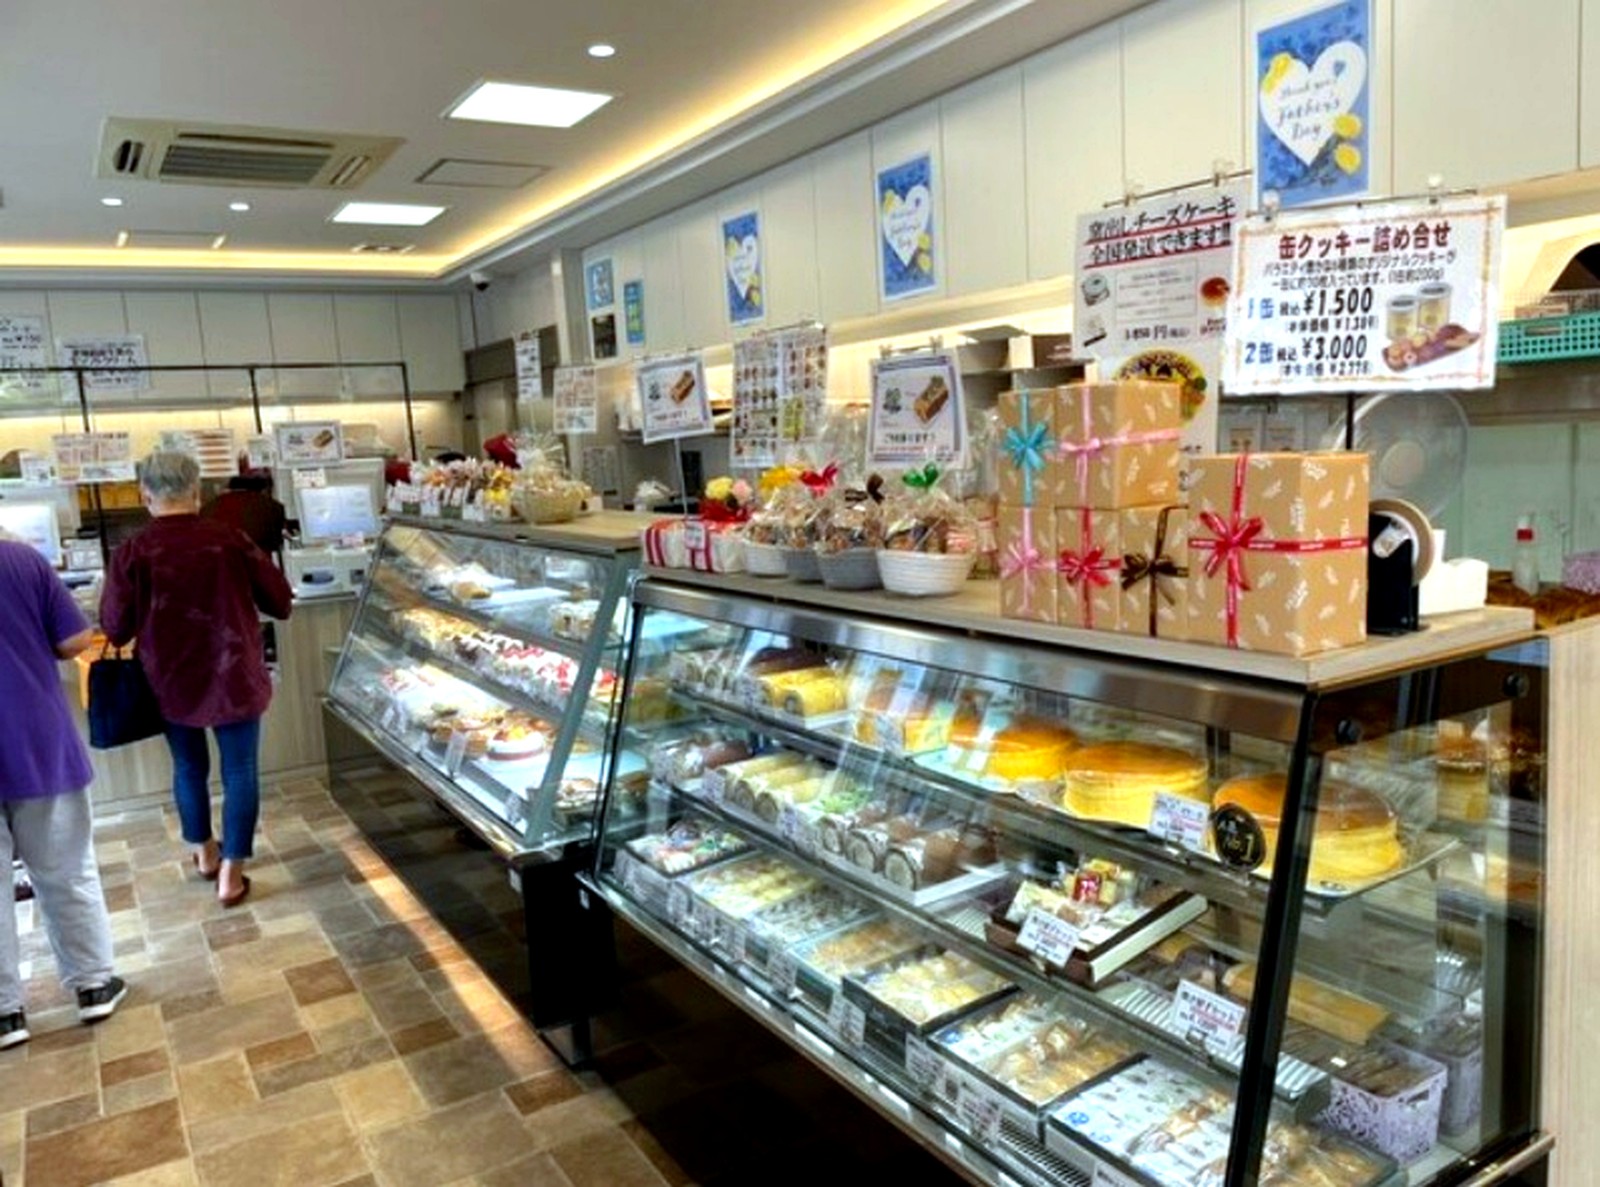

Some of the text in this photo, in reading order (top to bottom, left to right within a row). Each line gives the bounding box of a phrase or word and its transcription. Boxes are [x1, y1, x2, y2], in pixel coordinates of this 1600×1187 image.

[1278, 222, 1451, 260] 缶クッキー詰め合せ
[1245, 342, 1274, 364] 2缶
